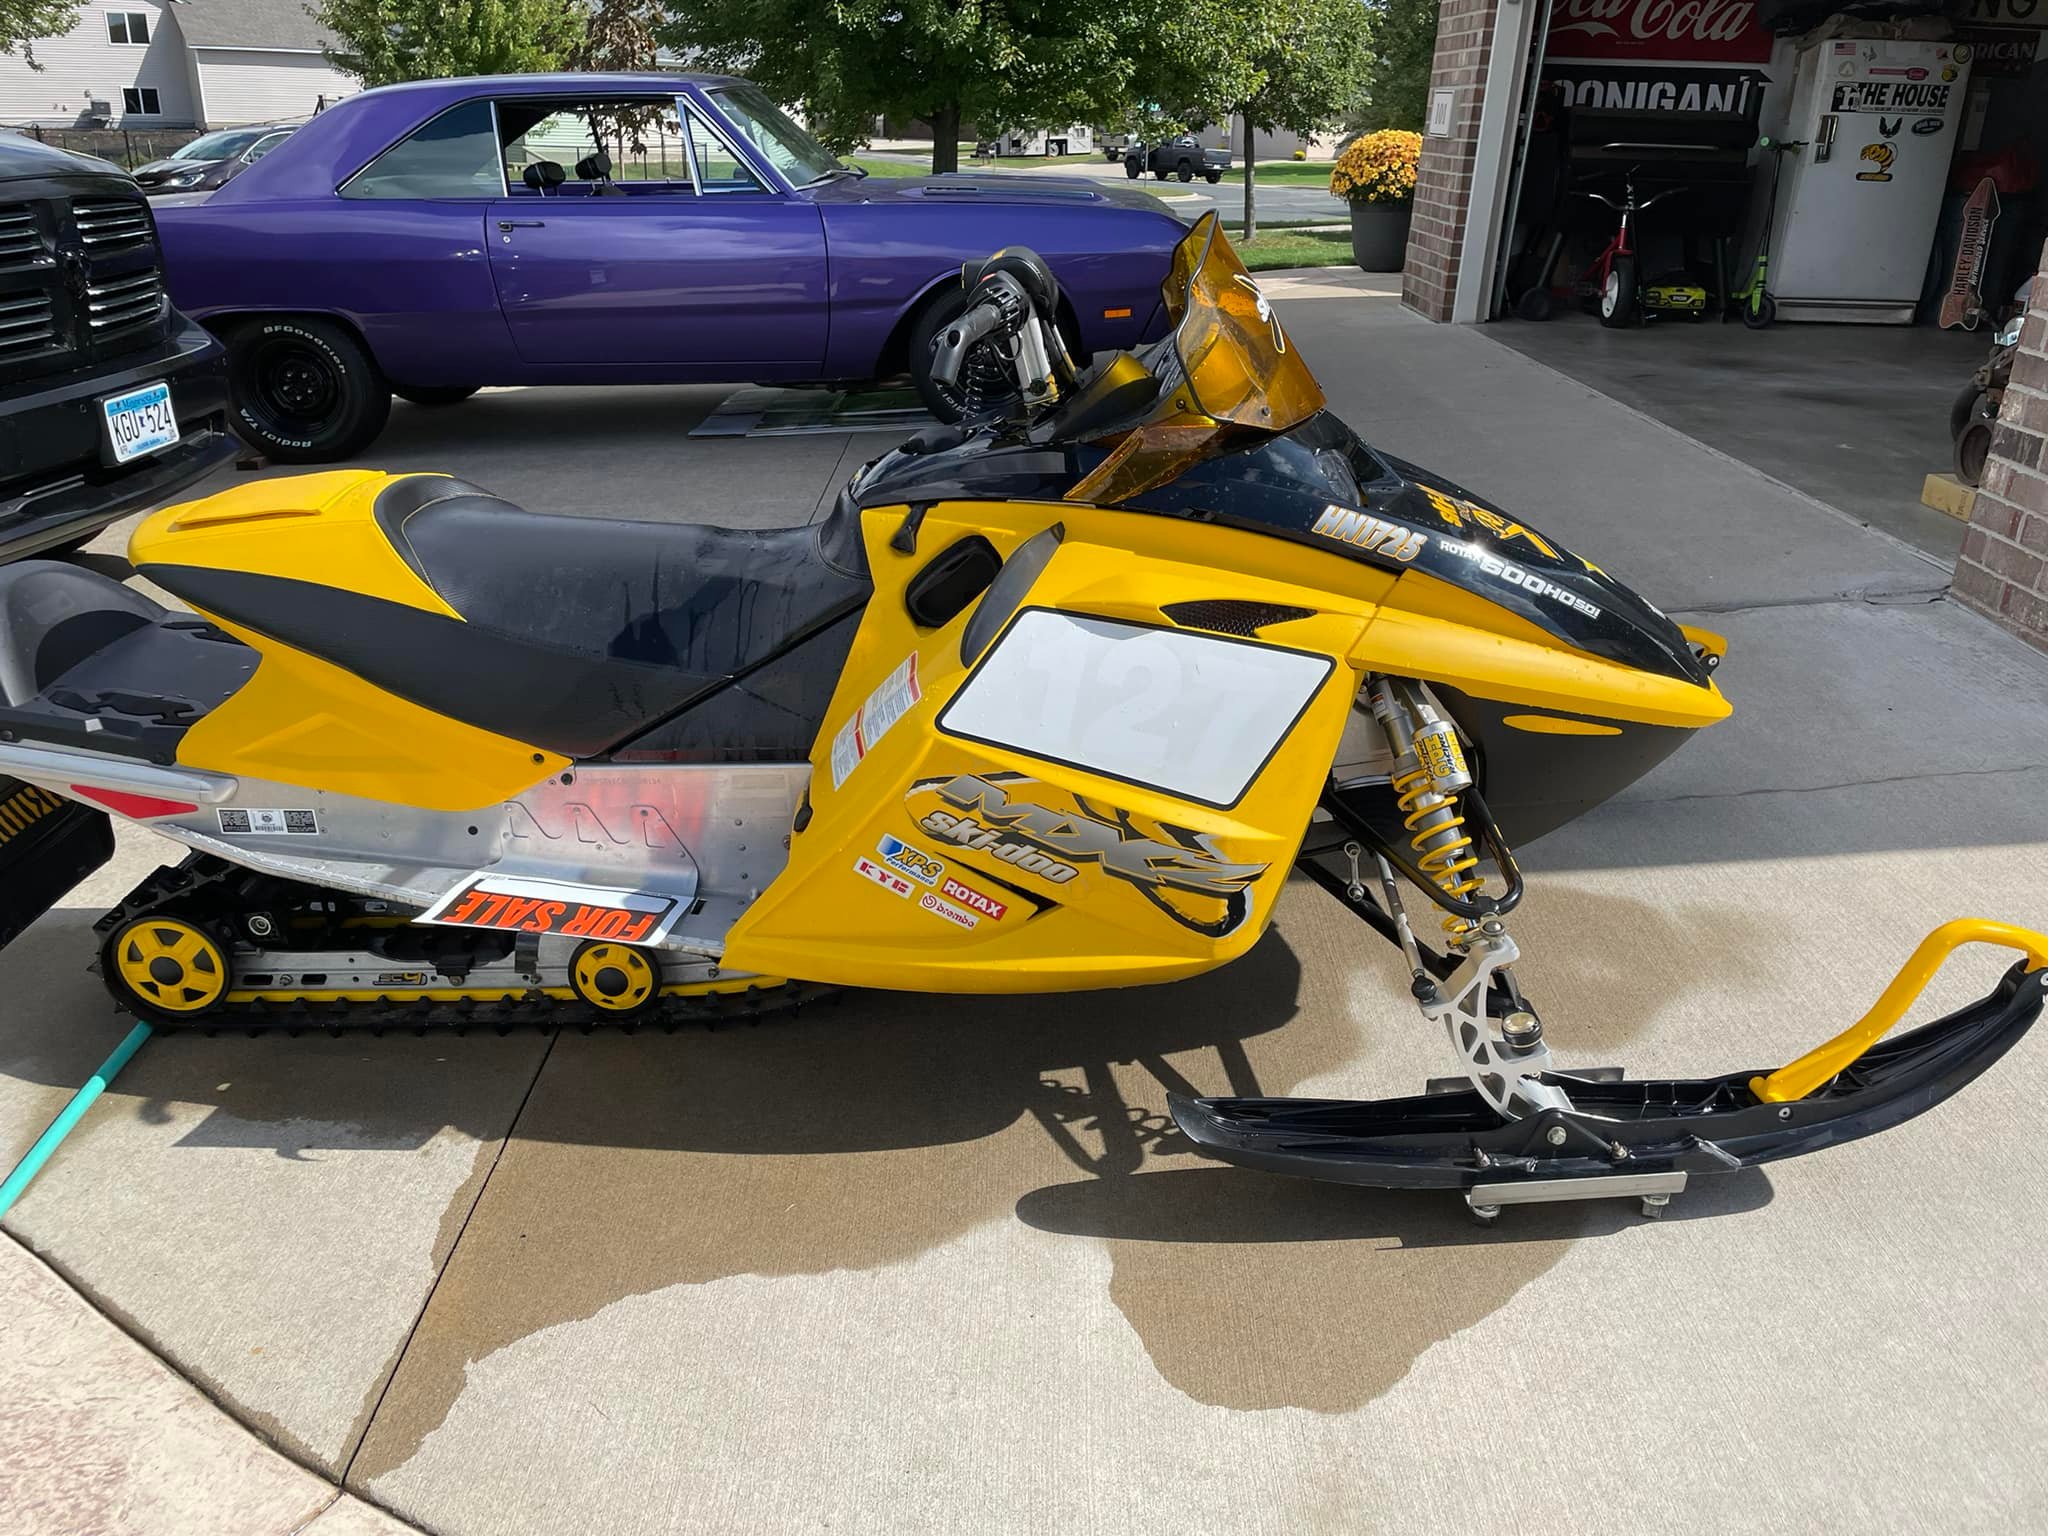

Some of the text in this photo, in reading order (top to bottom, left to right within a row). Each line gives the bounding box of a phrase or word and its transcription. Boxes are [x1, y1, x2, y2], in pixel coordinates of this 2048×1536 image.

[1857, 82, 1889, 106] THE
[1891, 84, 1950, 108] HOUSE
[1952, 207, 1983, 295] HARLEY-DAVIDSON
[859, 861, 1003, 917] KYB ROTAX
[886, 857, 936, 886] Performance
[442, 891, 656, 941] FOR SALE
[936, 904, 975, 928] brembo
